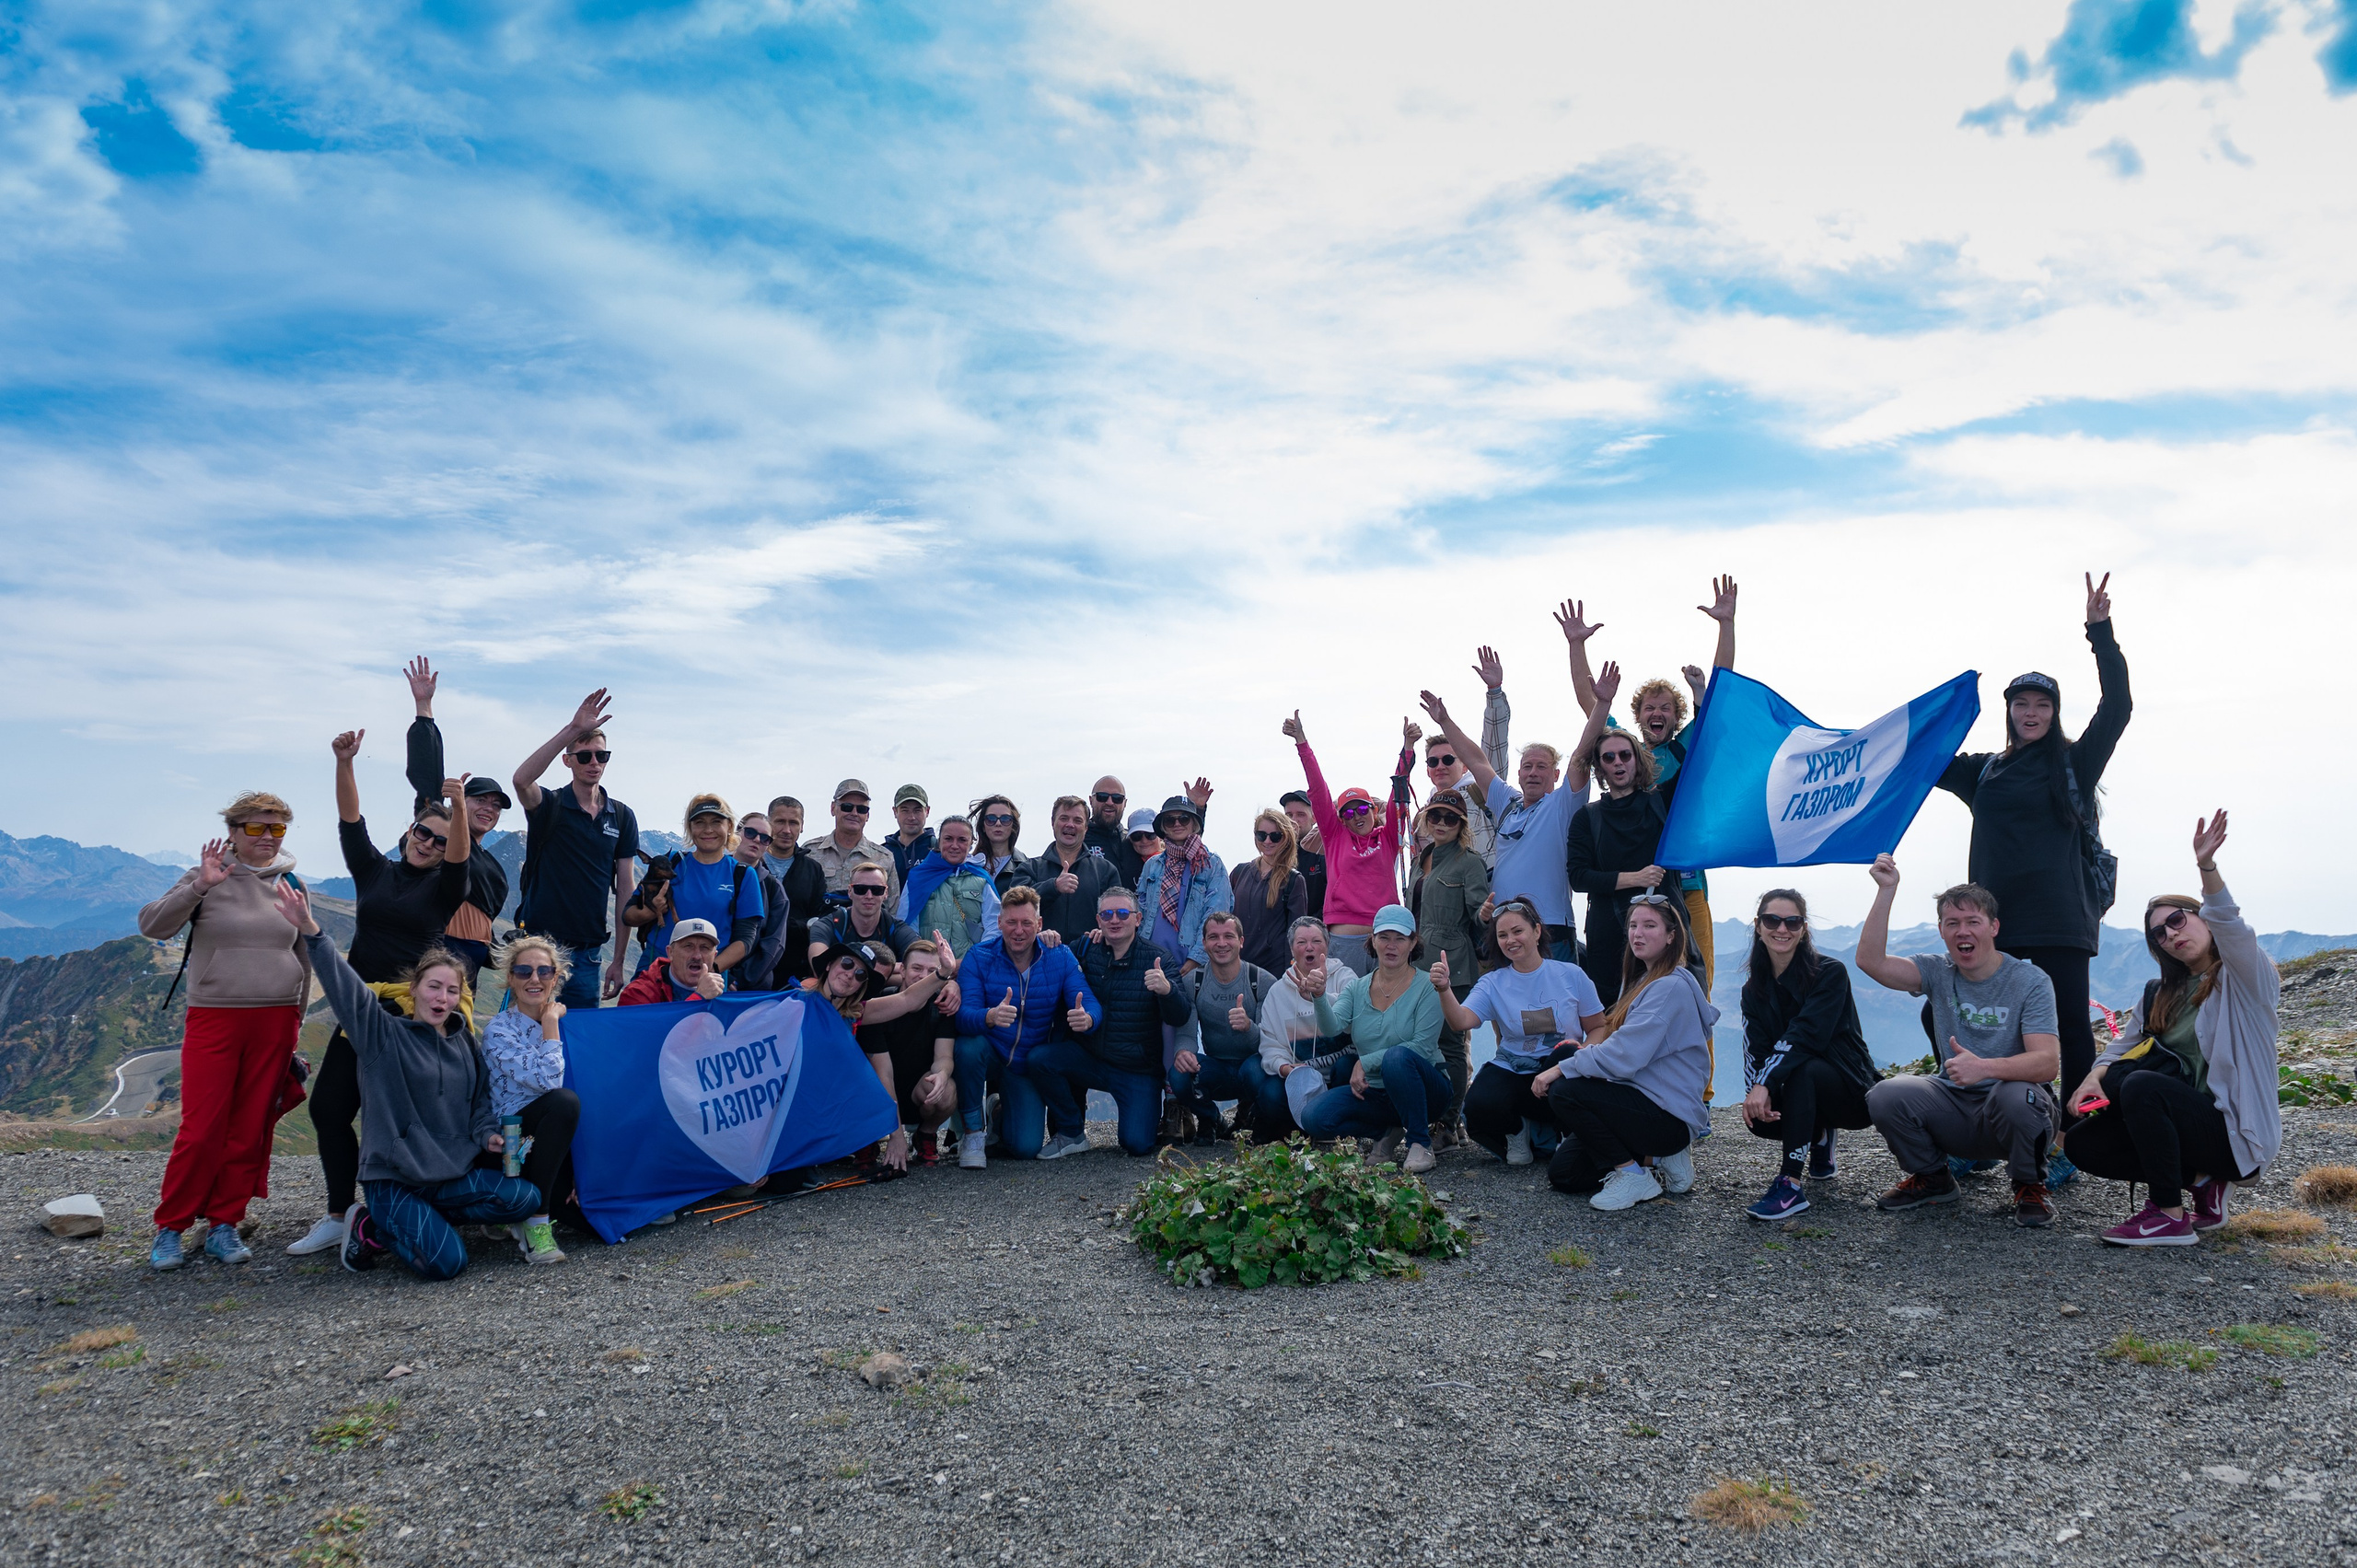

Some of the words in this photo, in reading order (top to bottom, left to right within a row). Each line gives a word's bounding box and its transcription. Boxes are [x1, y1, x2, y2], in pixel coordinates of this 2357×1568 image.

[1802, 738, 1868, 784] КУРОРТ
[1780, 776, 1866, 822] ГАЗПРОМ
[1211, 993, 1238, 1002] Völk
[695, 1034, 782, 1093] КУРОРТ
[1304, 1043, 1357, 1070] EMORIES
[699, 1073, 788, 1135] ГАЗПРО
